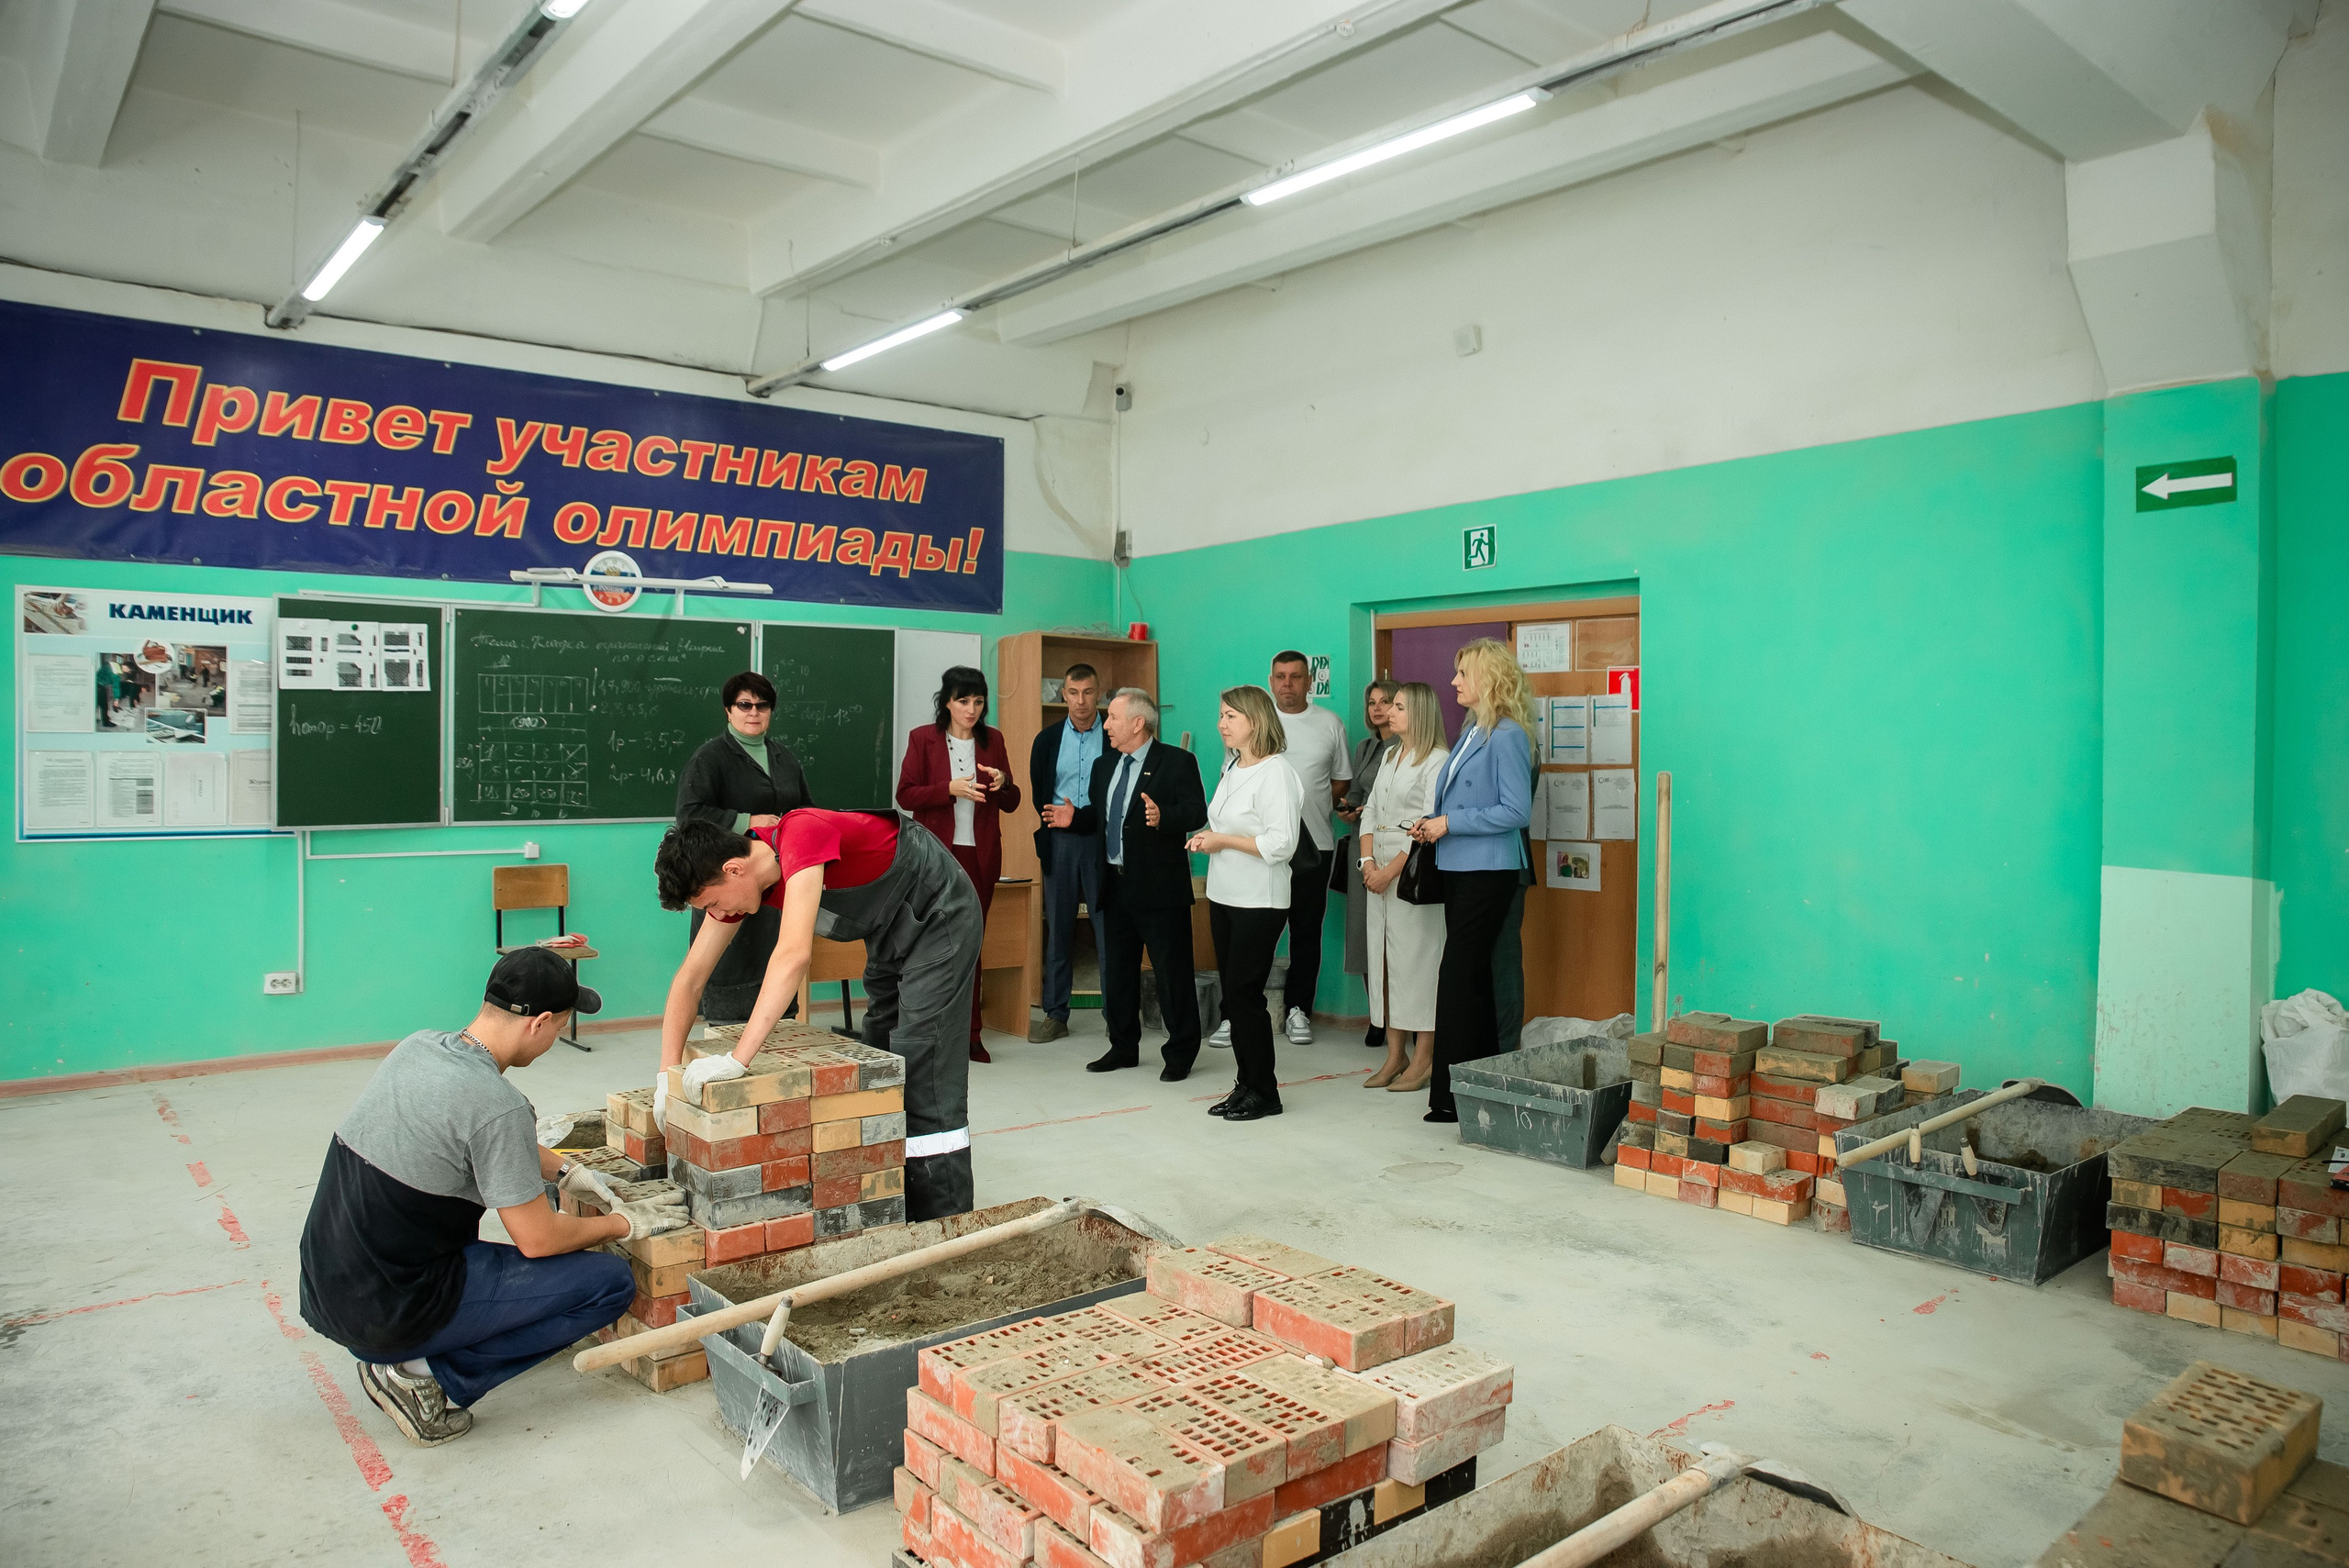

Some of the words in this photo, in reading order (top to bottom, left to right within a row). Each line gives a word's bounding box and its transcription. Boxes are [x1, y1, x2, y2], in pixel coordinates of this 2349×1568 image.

[117, 357, 473, 454] Привет
[486, 416, 928, 504] участникам
[0, 443, 530, 539] областной
[553, 501, 985, 578] олимпиады!
[108, 603, 253, 626] КАМЕНЩИК
